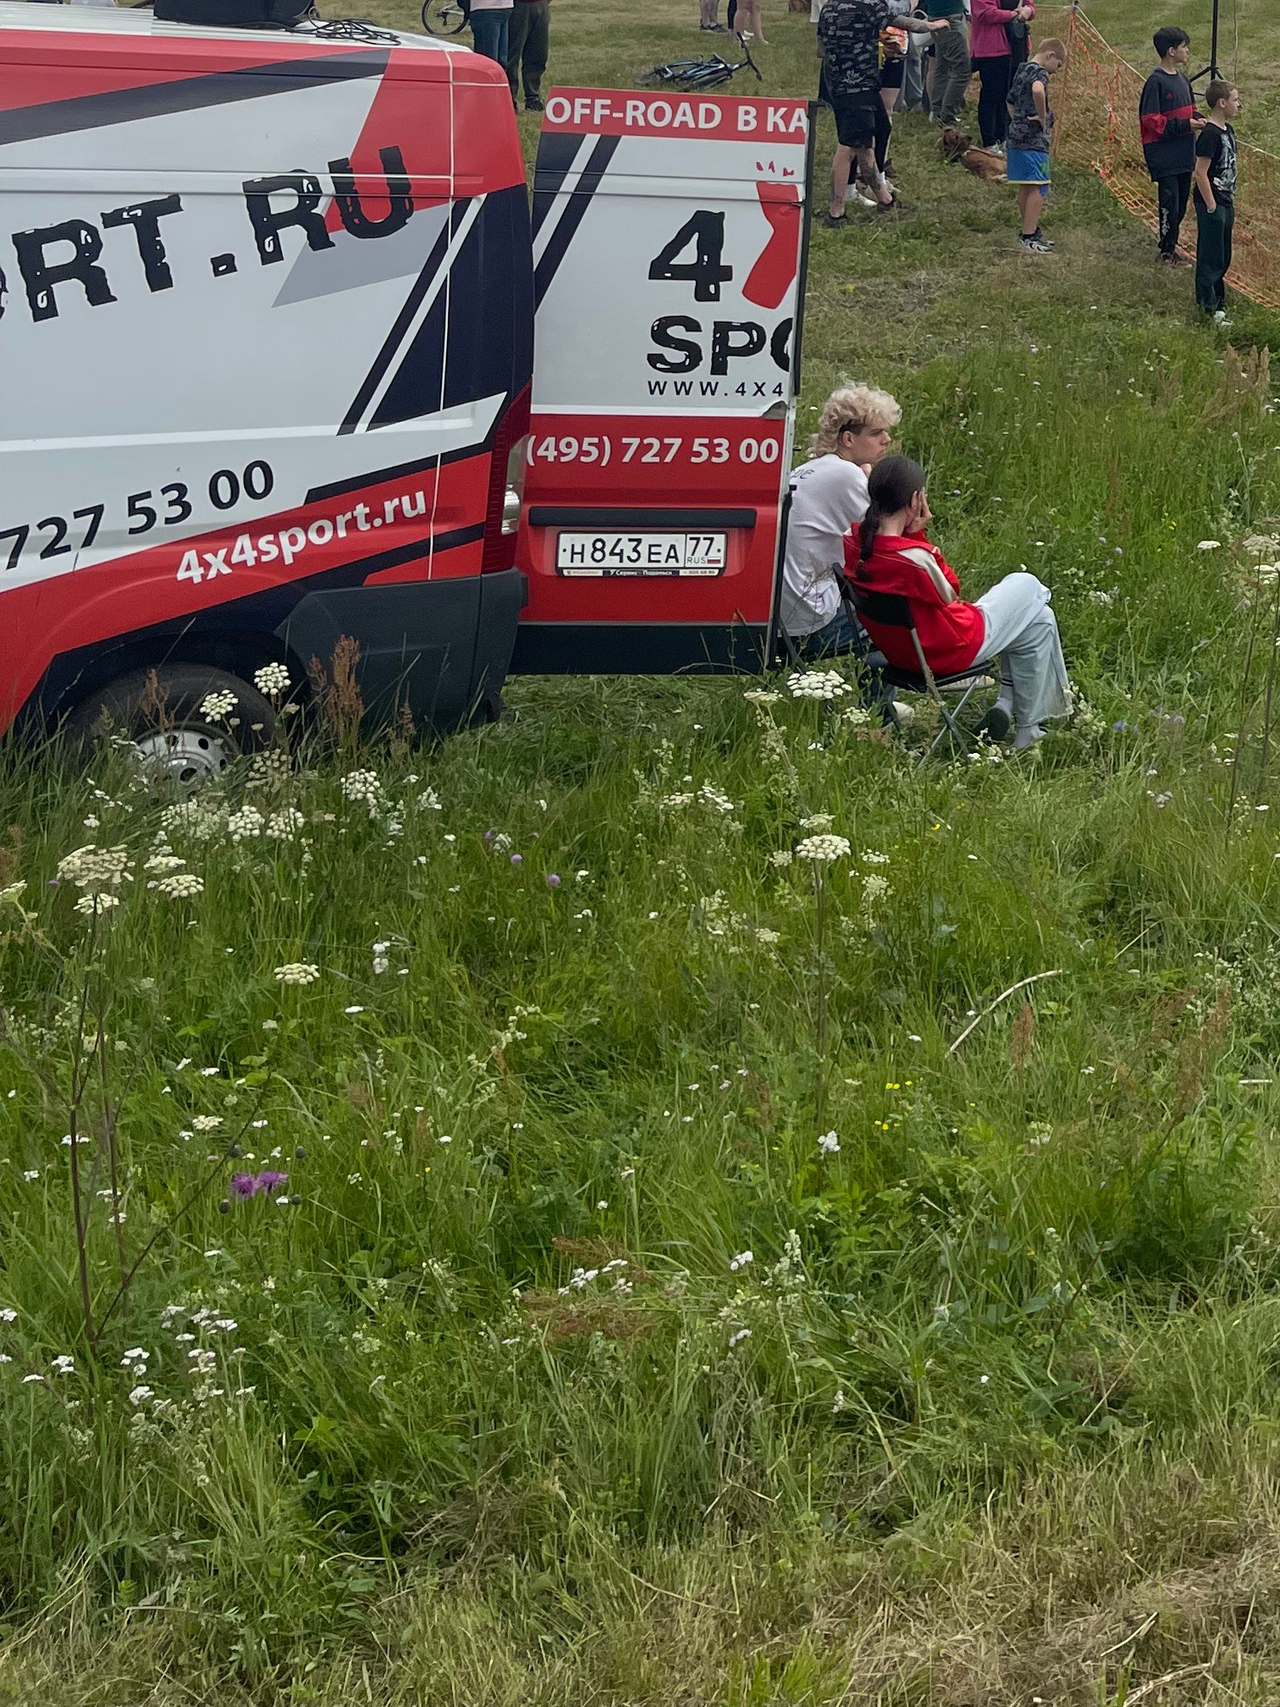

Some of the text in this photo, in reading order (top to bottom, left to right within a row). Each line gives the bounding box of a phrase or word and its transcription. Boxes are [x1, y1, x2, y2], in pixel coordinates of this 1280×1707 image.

[545, 96, 723, 129] OFF-ROAD
[0, 145, 414, 323] RT.RU
[526, 435, 780, 467] (495) 727 53 00
[0, 460, 274, 570] 727 53 00
[175, 490, 427, 584] 4x4sport.ru
[688, 537, 715, 556] 77
